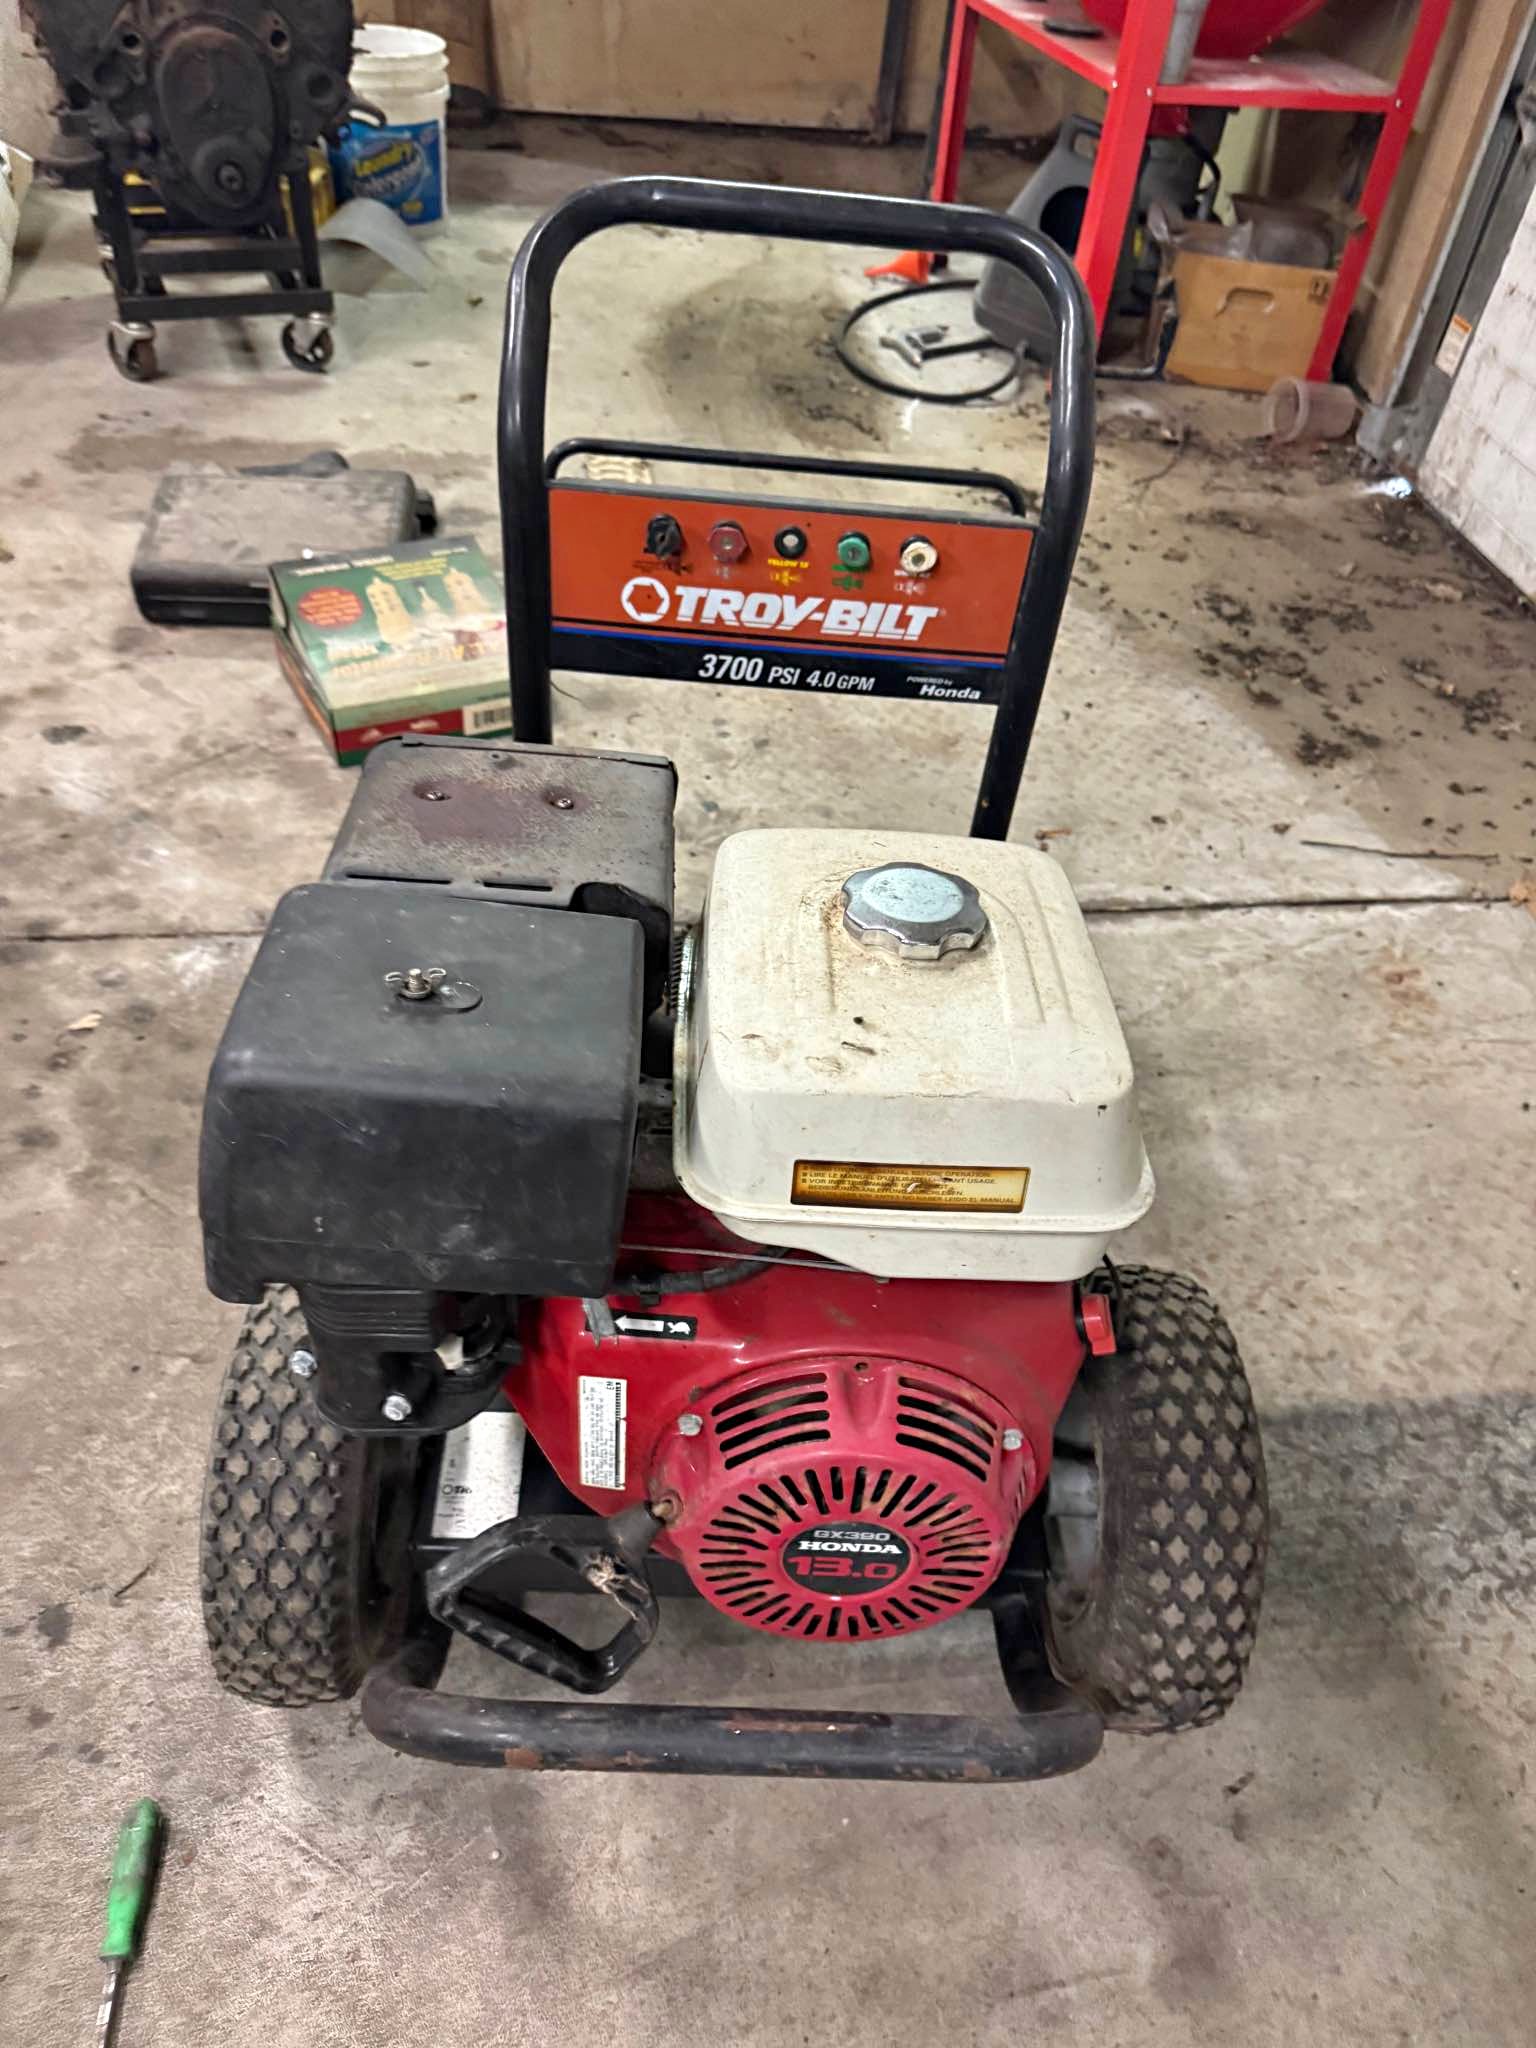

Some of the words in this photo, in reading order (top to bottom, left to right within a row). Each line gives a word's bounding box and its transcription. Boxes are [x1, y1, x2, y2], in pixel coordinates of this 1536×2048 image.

[674, 585, 939, 642] TROY-BILT
[697, 653, 764, 683] 3700
[767, 665, 802, 686] PSI
[805, 669, 836, 690] 4.0
[836, 674, 876, 692] GPM
[919, 684, 982, 700] Honda
[813, 1529, 892, 1542] GX390
[797, 1540, 904, 1555] HONDA
[787, 1555, 898, 1580] 13.0
